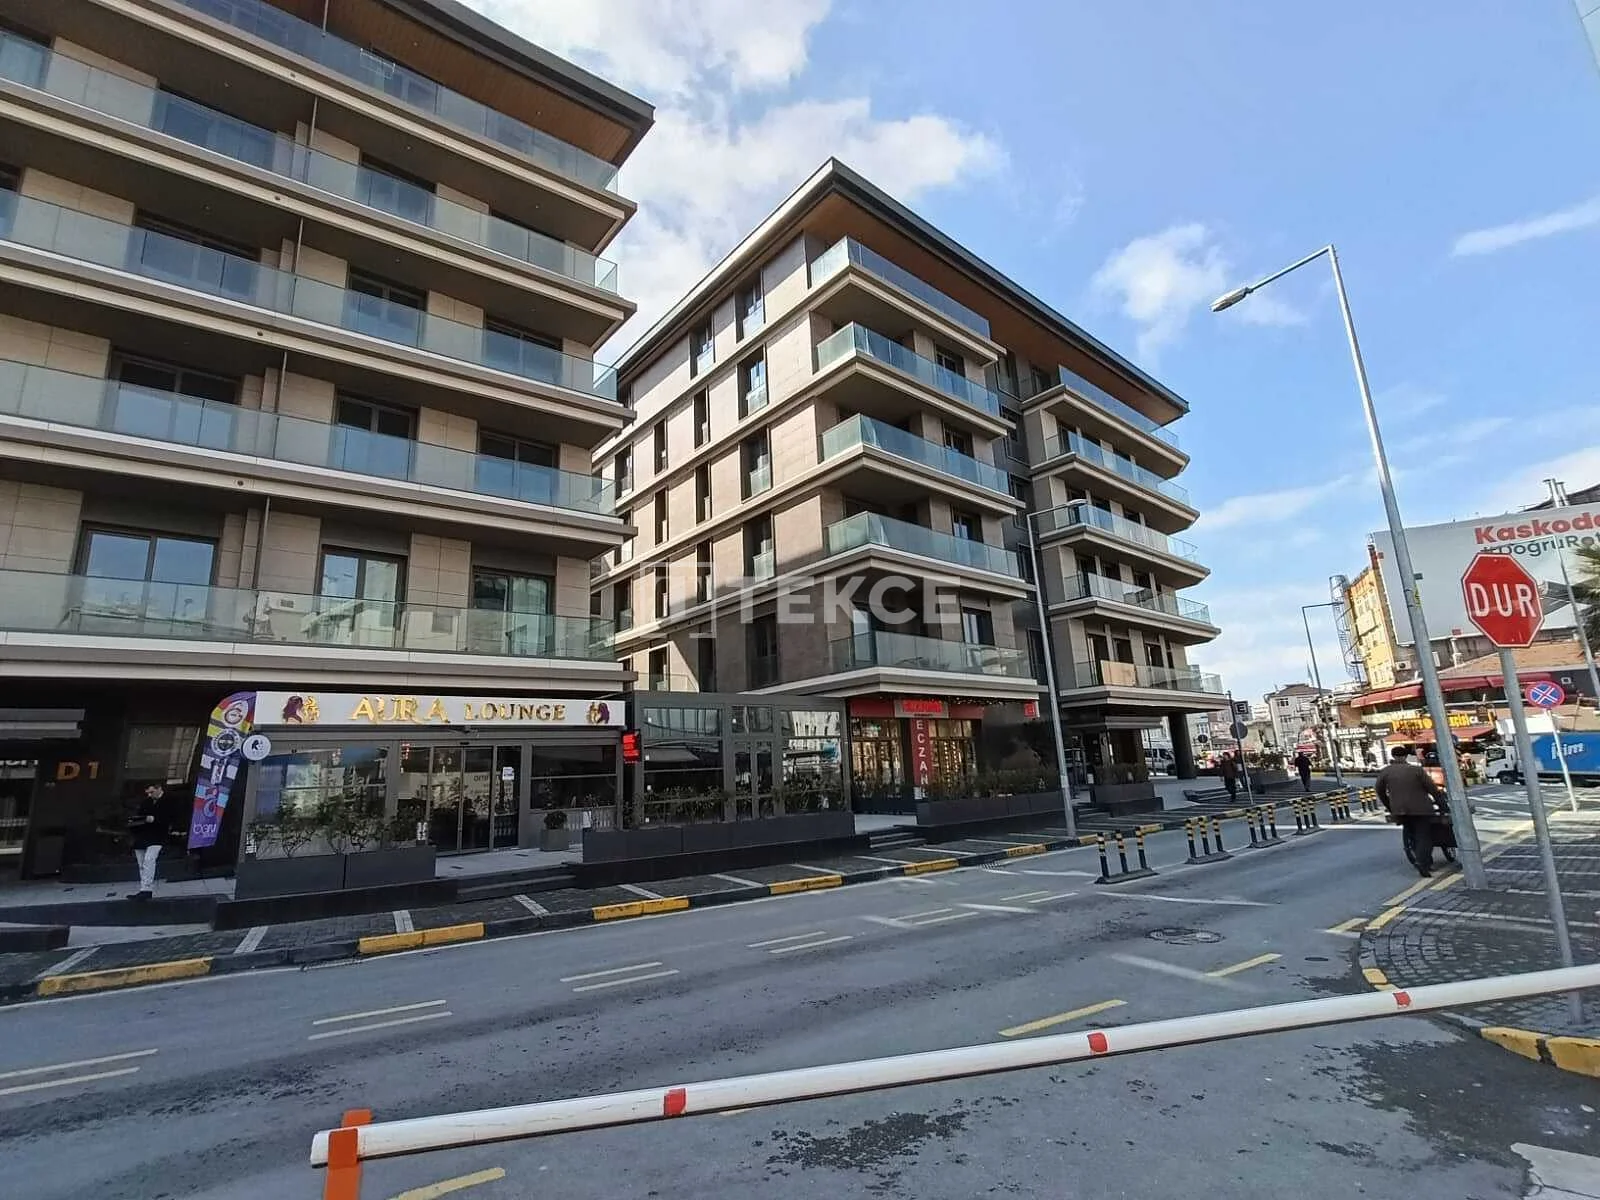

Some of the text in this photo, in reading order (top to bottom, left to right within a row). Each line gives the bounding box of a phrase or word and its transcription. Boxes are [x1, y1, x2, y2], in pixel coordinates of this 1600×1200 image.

[1470, 582, 1537, 618] DUR
[349, 696, 566, 724] AURA LOUNGE
